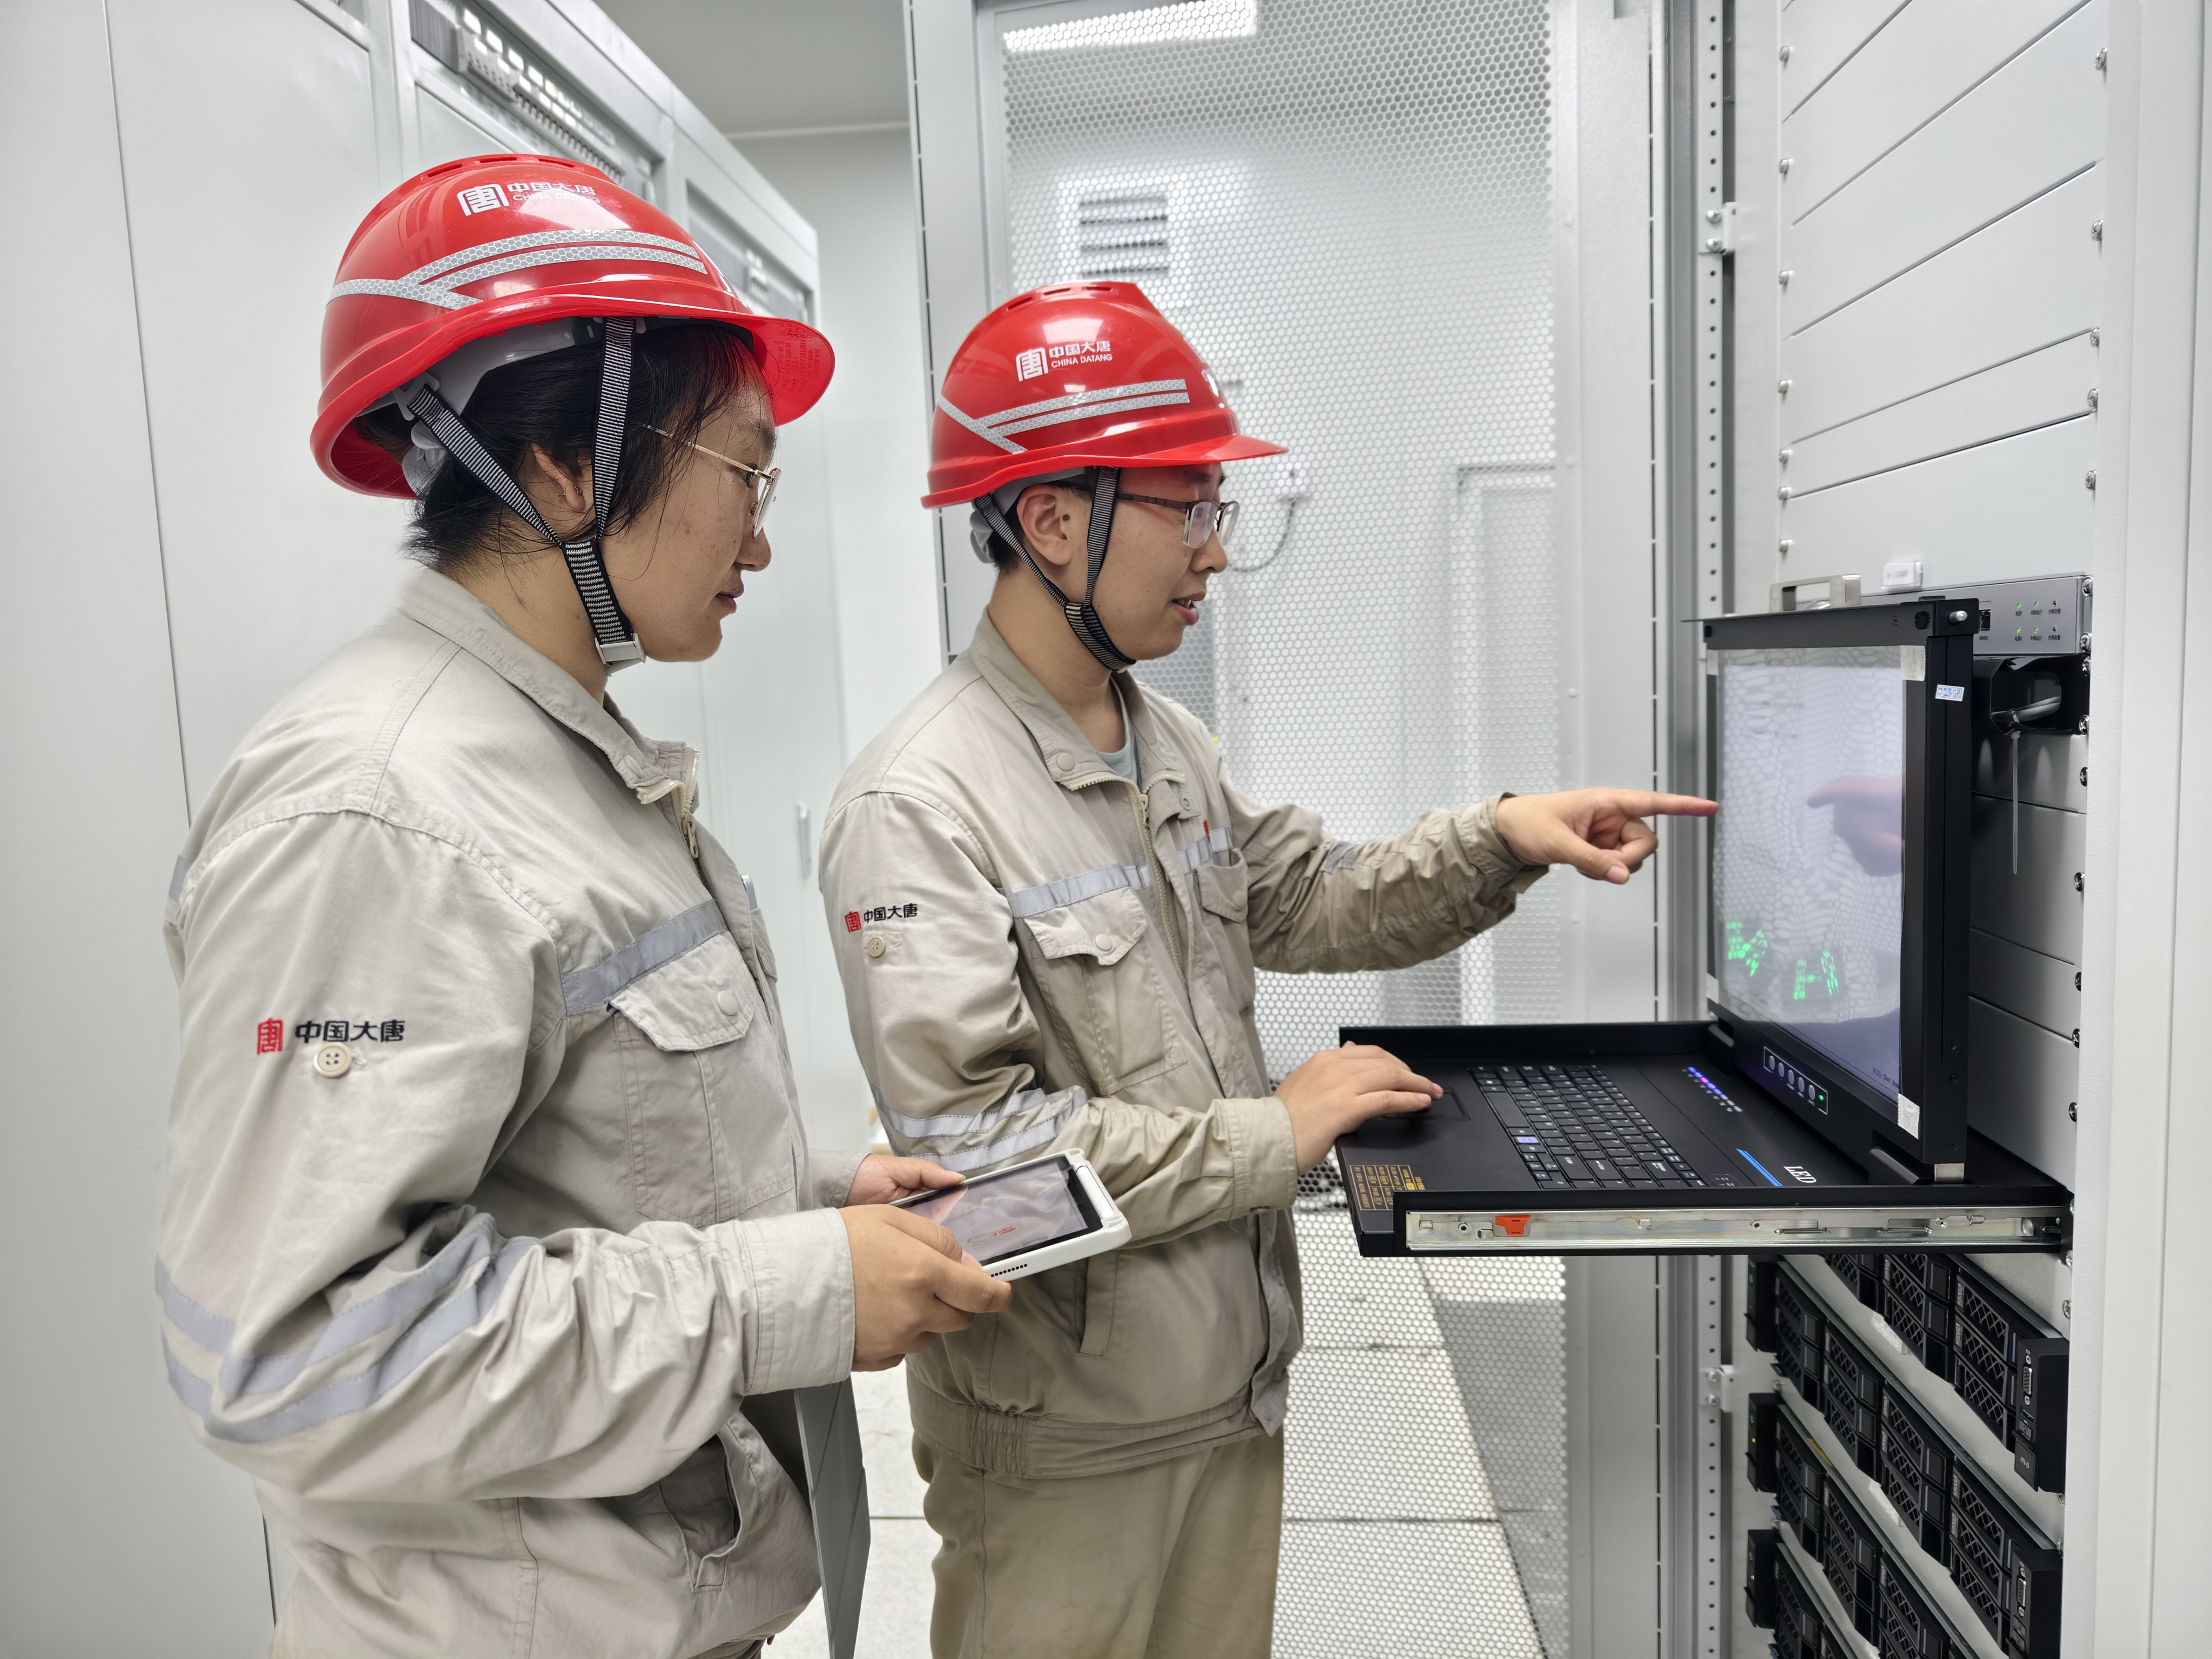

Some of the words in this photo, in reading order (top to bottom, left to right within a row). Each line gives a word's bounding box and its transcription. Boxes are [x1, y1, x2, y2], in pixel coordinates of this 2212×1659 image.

[507, 182, 596, 196] 中国大唐
[513, 193, 551, 202] CHINA
[555, 193, 601, 205] DATANG
[1049, 341, 1111, 359] 中国大唐
[1051, 357, 1079, 368] CHINA
[1080, 354, 1113, 364] DATANG
[864, 903, 918, 923] 中国大唐
[295, 1019, 406, 1043] 中国大唐
[1783, 1165, 1817, 1184] LED
